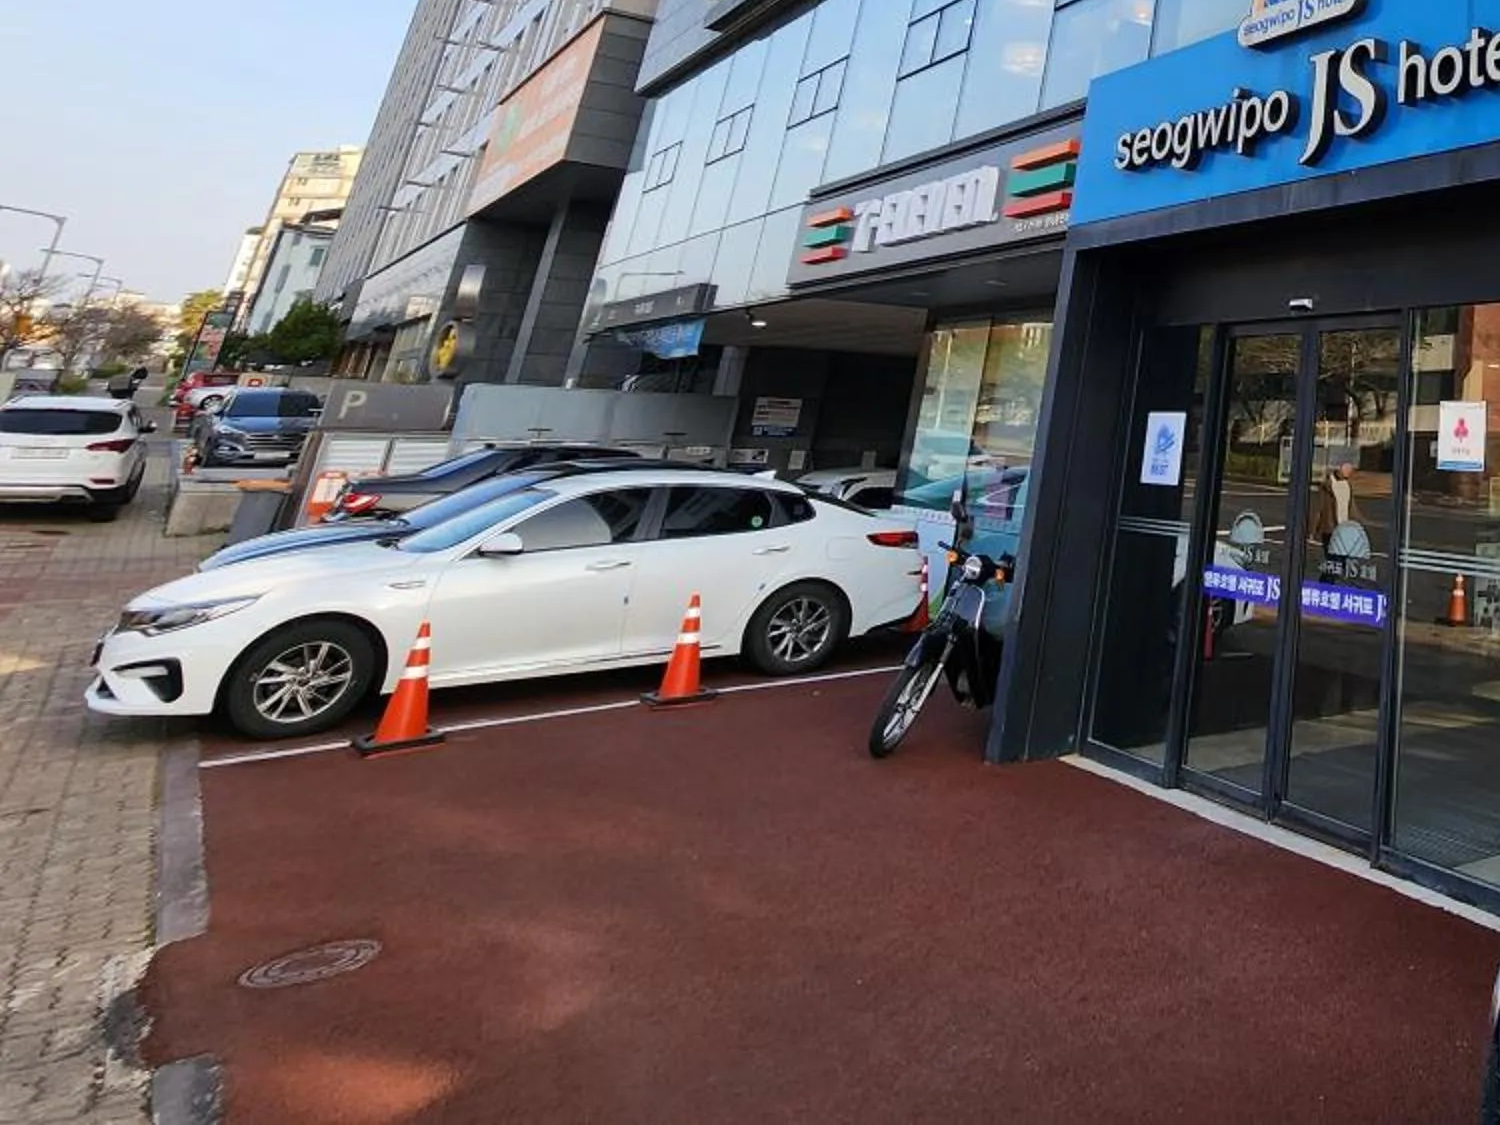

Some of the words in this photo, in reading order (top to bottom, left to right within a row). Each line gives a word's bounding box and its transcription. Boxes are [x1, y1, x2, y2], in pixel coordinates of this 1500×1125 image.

[1243, 8, 1295, 36] seogwipo
[1114, 86, 1294, 171] seogwipo
[1300, 38, 1383, 166] JS
[338, 390, 369, 420] P
[1265, 577, 1281, 602] JS
